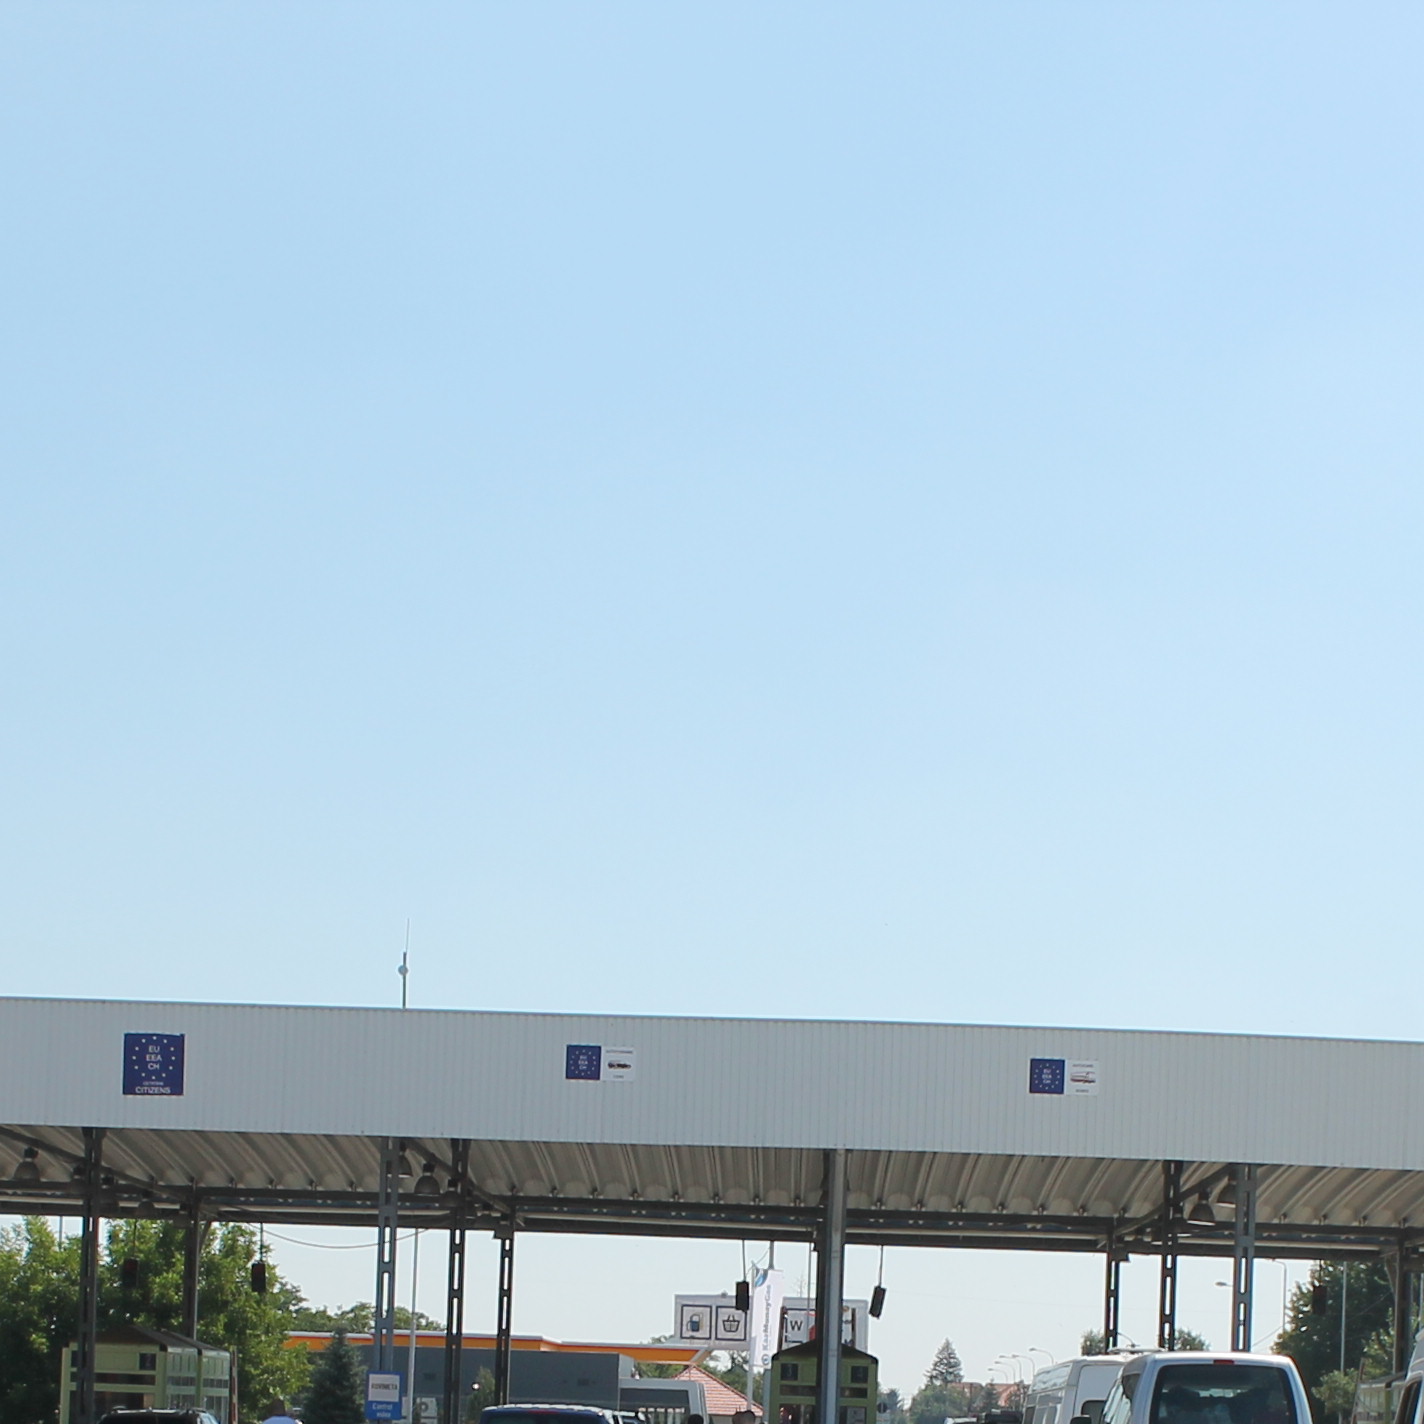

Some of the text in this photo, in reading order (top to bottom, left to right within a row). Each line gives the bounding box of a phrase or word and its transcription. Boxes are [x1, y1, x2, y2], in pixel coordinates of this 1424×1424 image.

[148, 1045, 160, 1053] EU
[146, 1054, 162, 1062] EEA
[135, 1086, 171, 1094] CITIZENS
